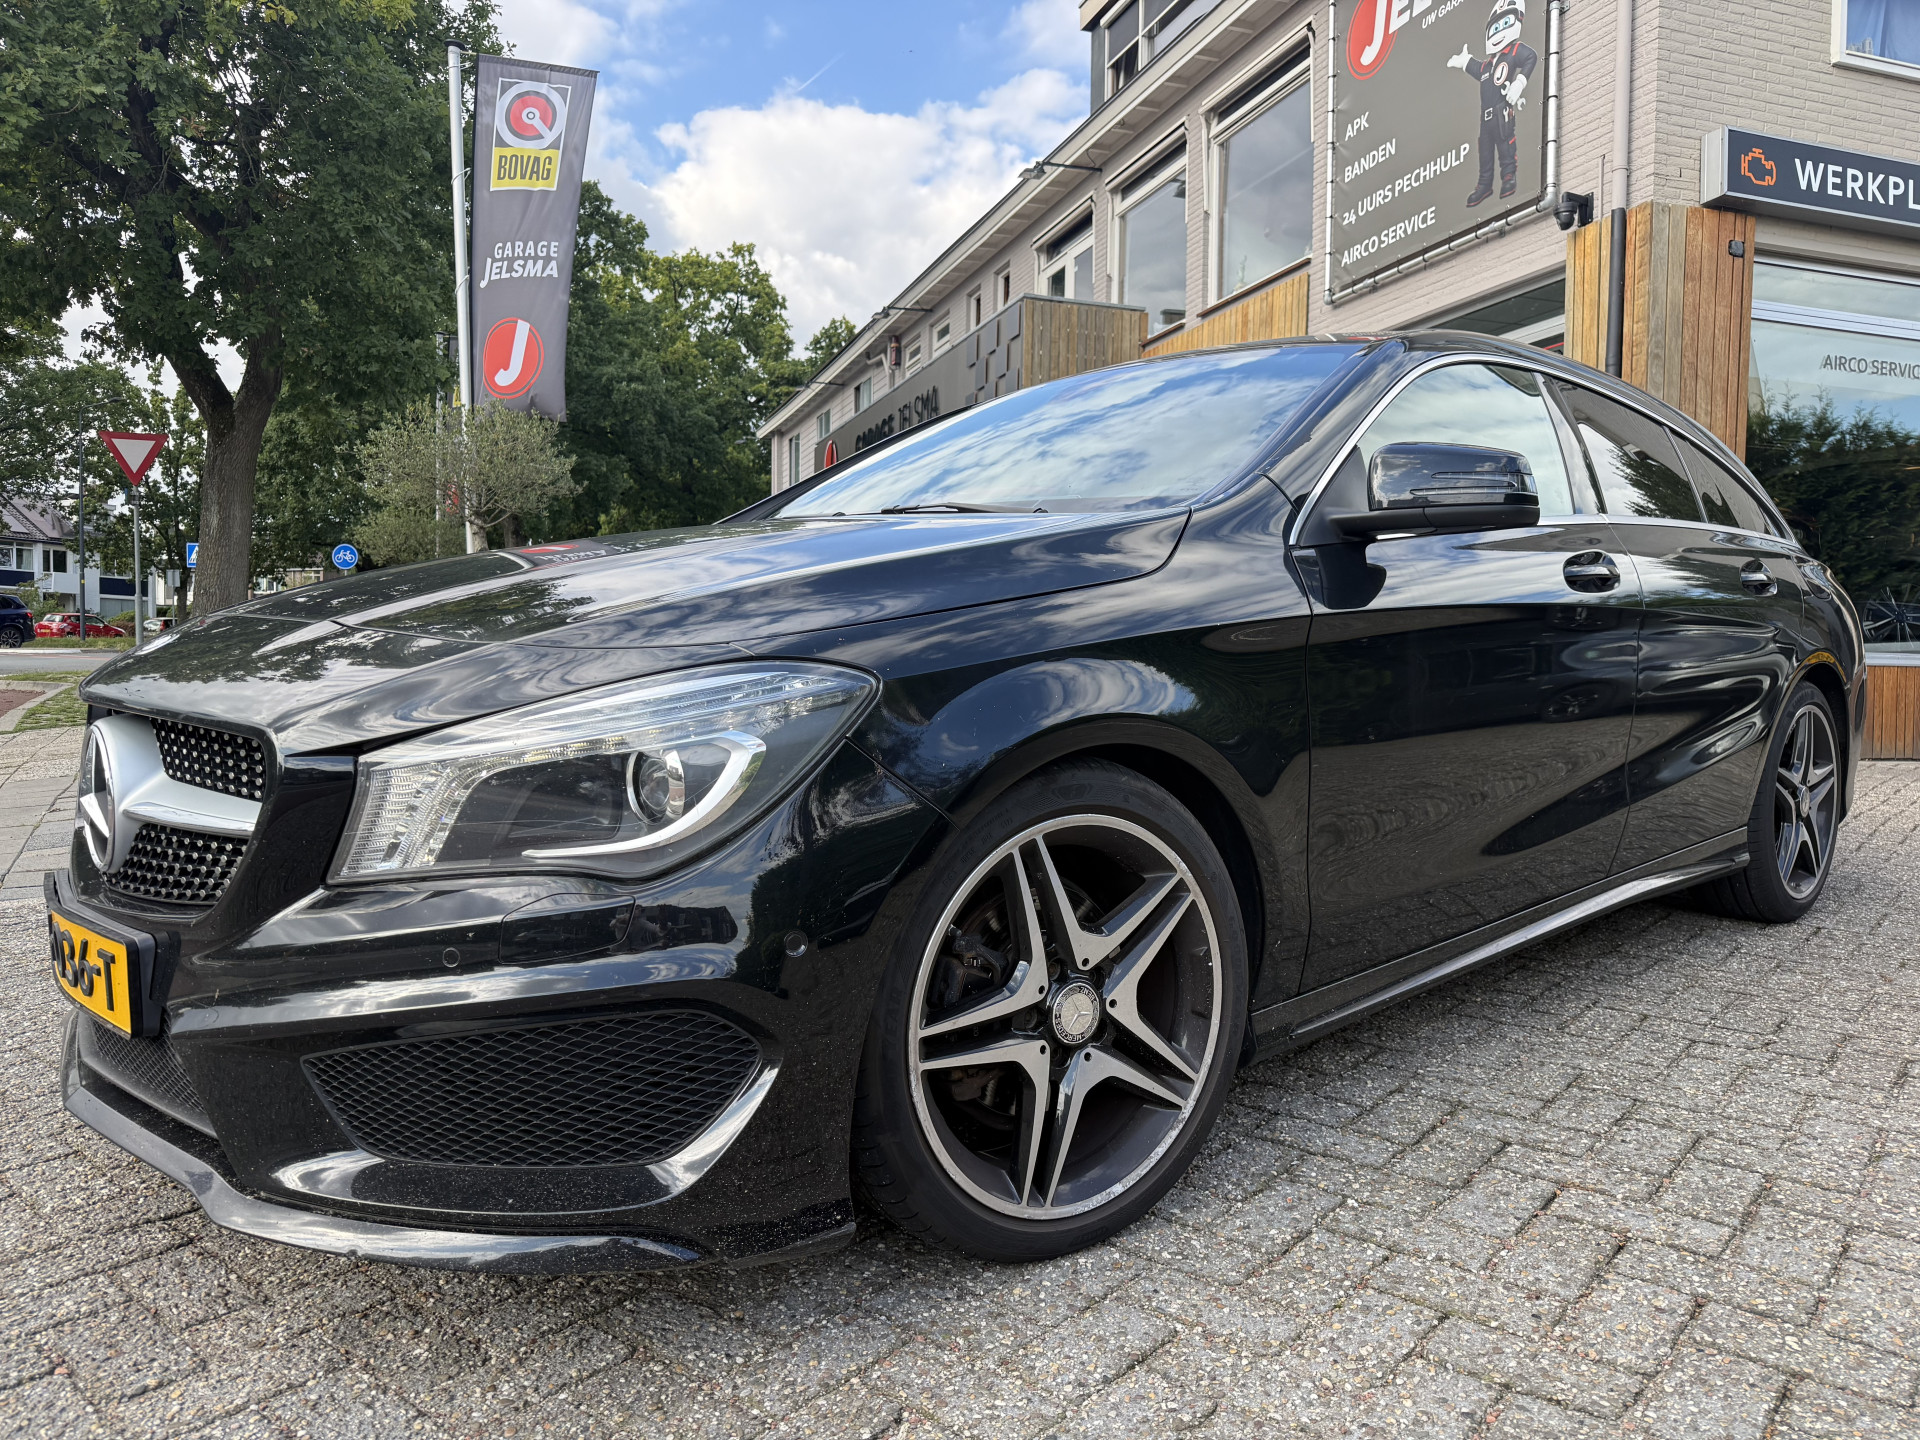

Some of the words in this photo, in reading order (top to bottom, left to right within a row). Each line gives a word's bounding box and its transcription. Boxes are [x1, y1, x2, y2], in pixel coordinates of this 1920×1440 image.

[1422, 9, 1437, 29] UW
[1438, 0, 1464, 17] GAR
[1345, 112, 1369, 141] APK
[497, 154, 553, 181] BOVAG
[1345, 138, 1396, 183] BANDEN
[1343, 209, 1357, 226] 24
[1358, 184, 1392, 216] UURS
[1395, 143, 1470, 197] PECHHULP
[1794, 158, 1920, 211] WERKPL
[494, 240, 559, 259] GARAGE
[1341, 235, 1379, 267] AIRCO
[1380, 206, 1436, 248] SERVICE
[480, 257, 559, 289] JELSMA
[494, 319, 531, 387] J
[1823, 354, 1868, 374] AIRCO
[1871, 359, 1920, 380] SERVIC
